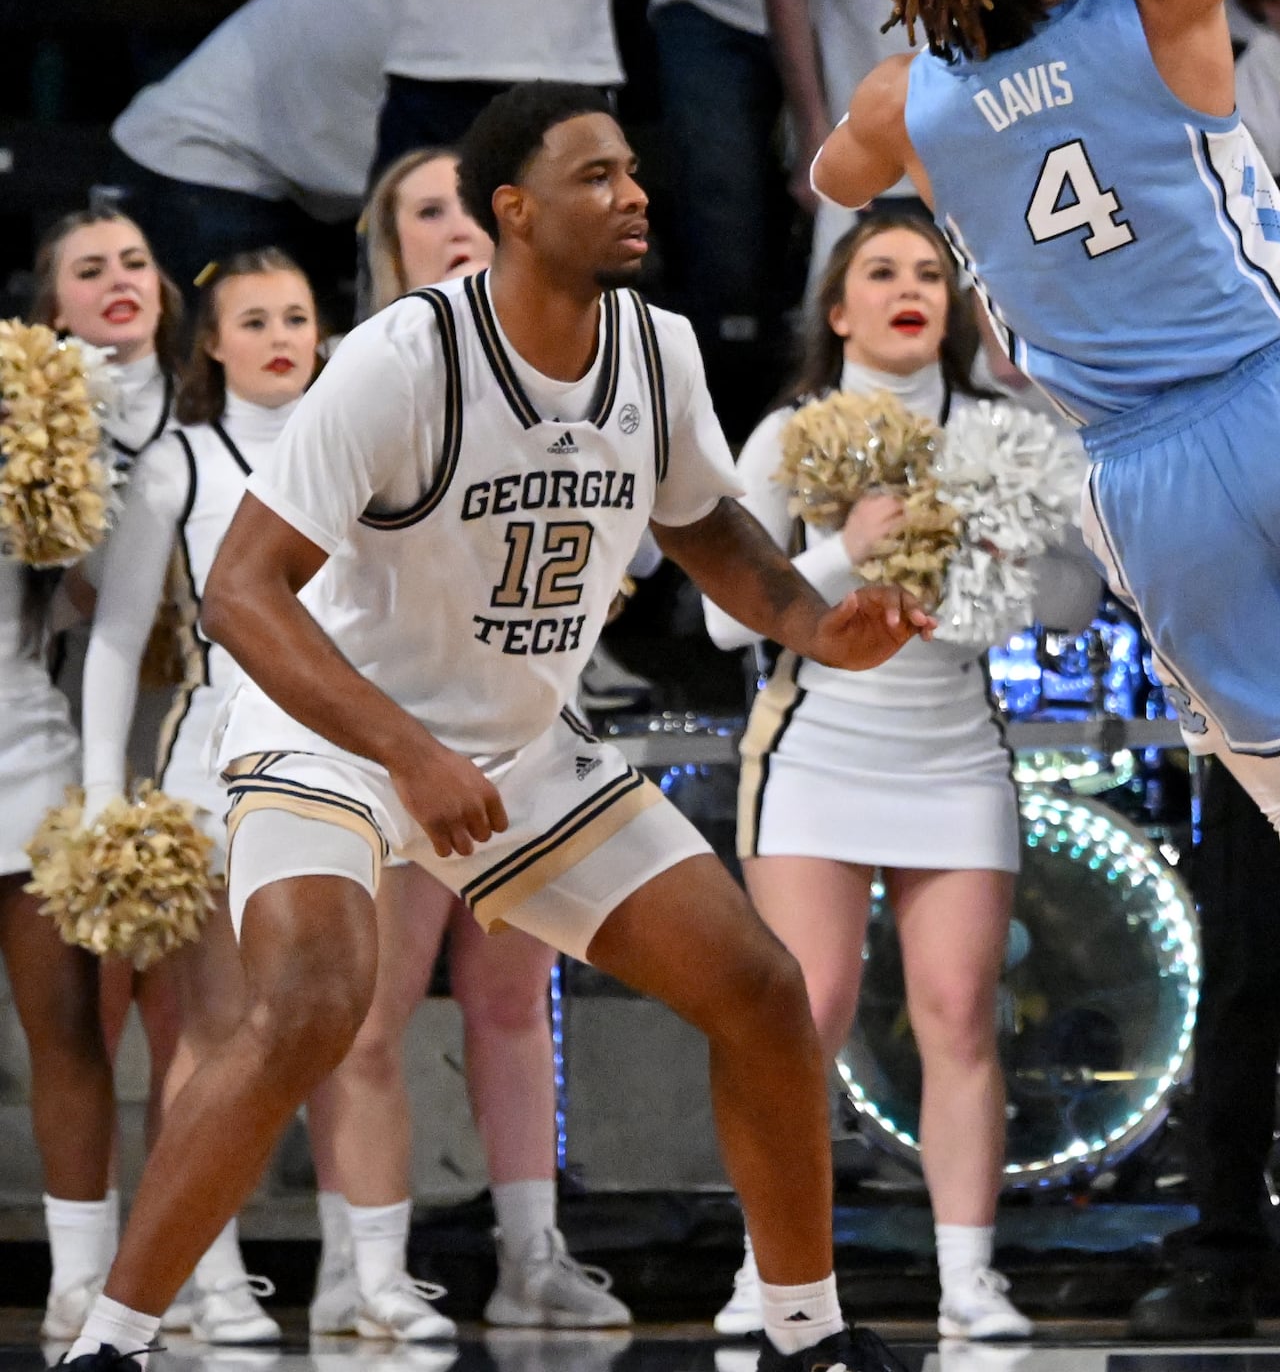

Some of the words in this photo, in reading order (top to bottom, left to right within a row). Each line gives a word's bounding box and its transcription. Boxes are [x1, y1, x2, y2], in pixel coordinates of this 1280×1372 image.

[972, 60, 1074, 133] DAVIS
[1024, 138, 1138, 260] 4
[460, 470, 636, 521] GEORGIA
[490, 521, 595, 609] 12
[473, 614, 587, 656] TECH
